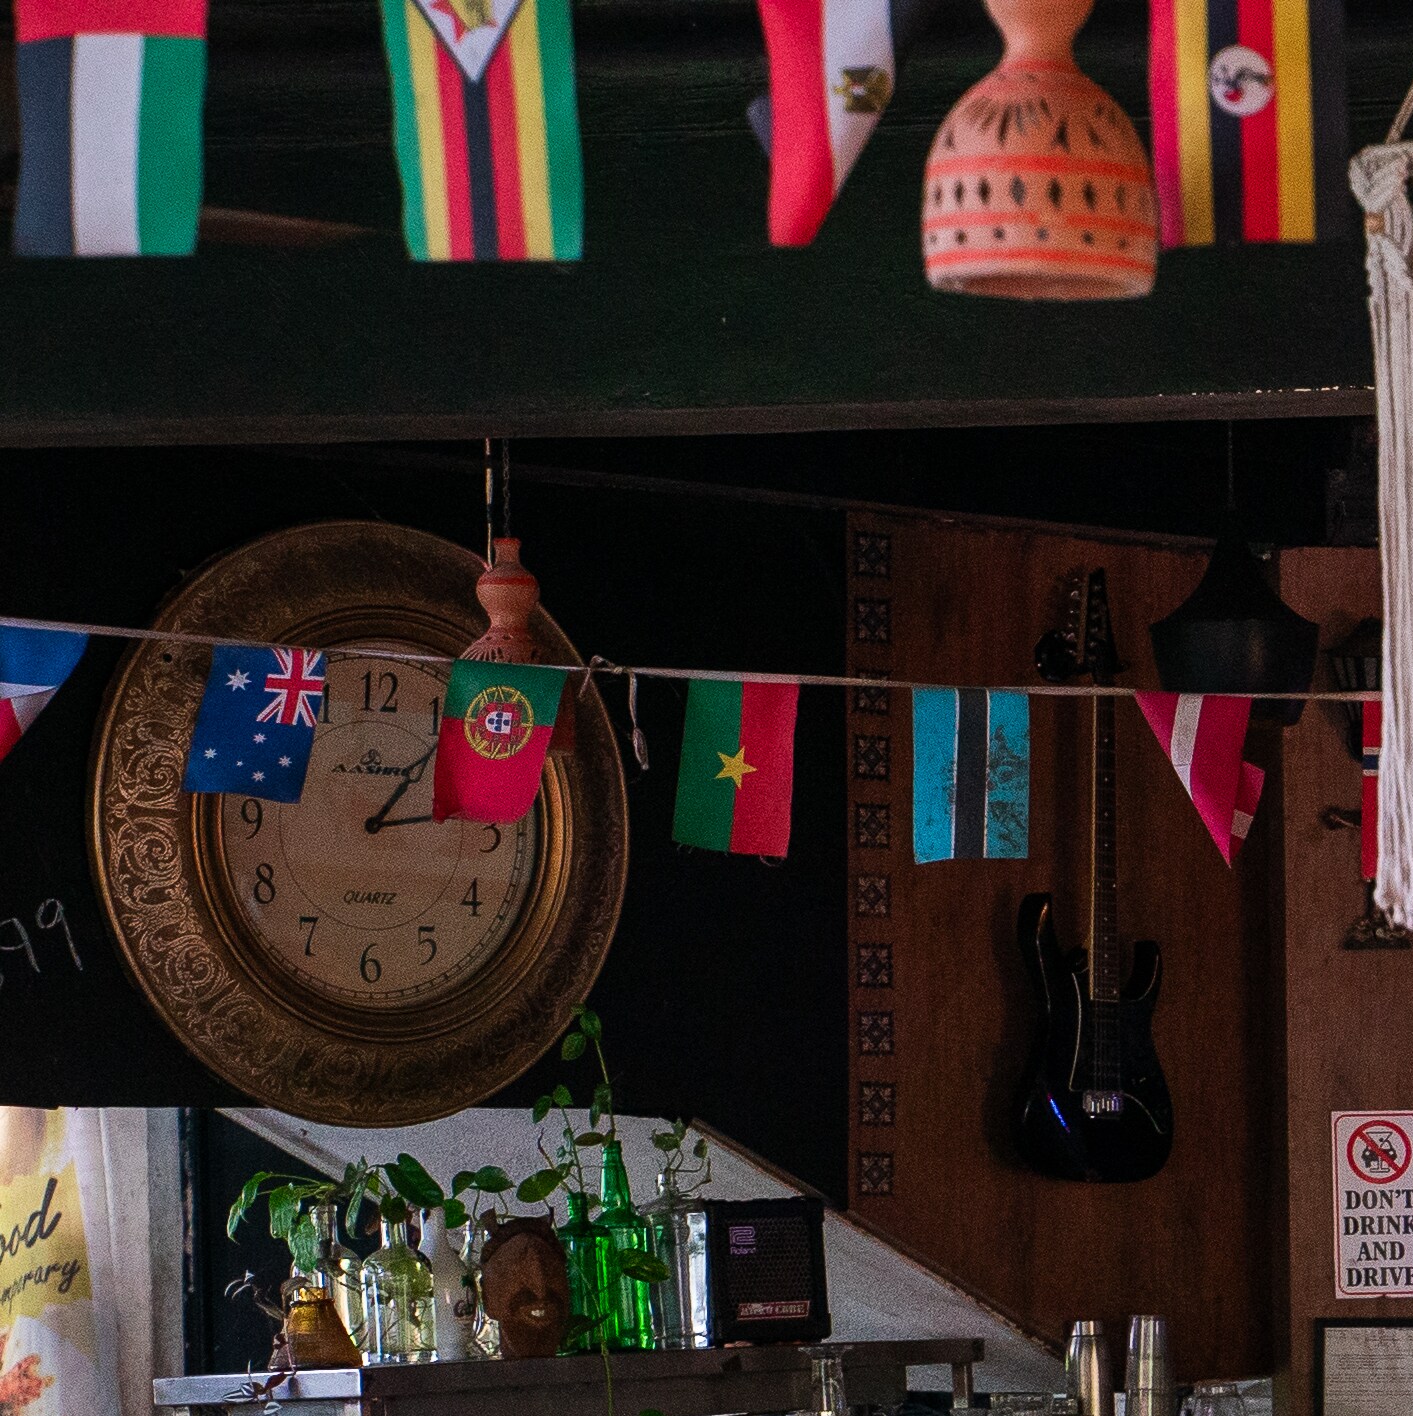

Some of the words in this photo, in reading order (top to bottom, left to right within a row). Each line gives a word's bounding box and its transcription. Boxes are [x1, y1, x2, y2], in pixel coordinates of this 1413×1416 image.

[361, 671, 399, 713] 12
[241, 798, 263, 840] 9
[253, 863, 277, 904] 8
[343, 892, 398, 906] QUARTZ
[460, 878, 483, 917] 4
[300, 917, 319, 957] 7
[417, 926, 437, 965] 5
[359, 943, 383, 984] 6
[1357, 1241, 1405, 1262] AND
